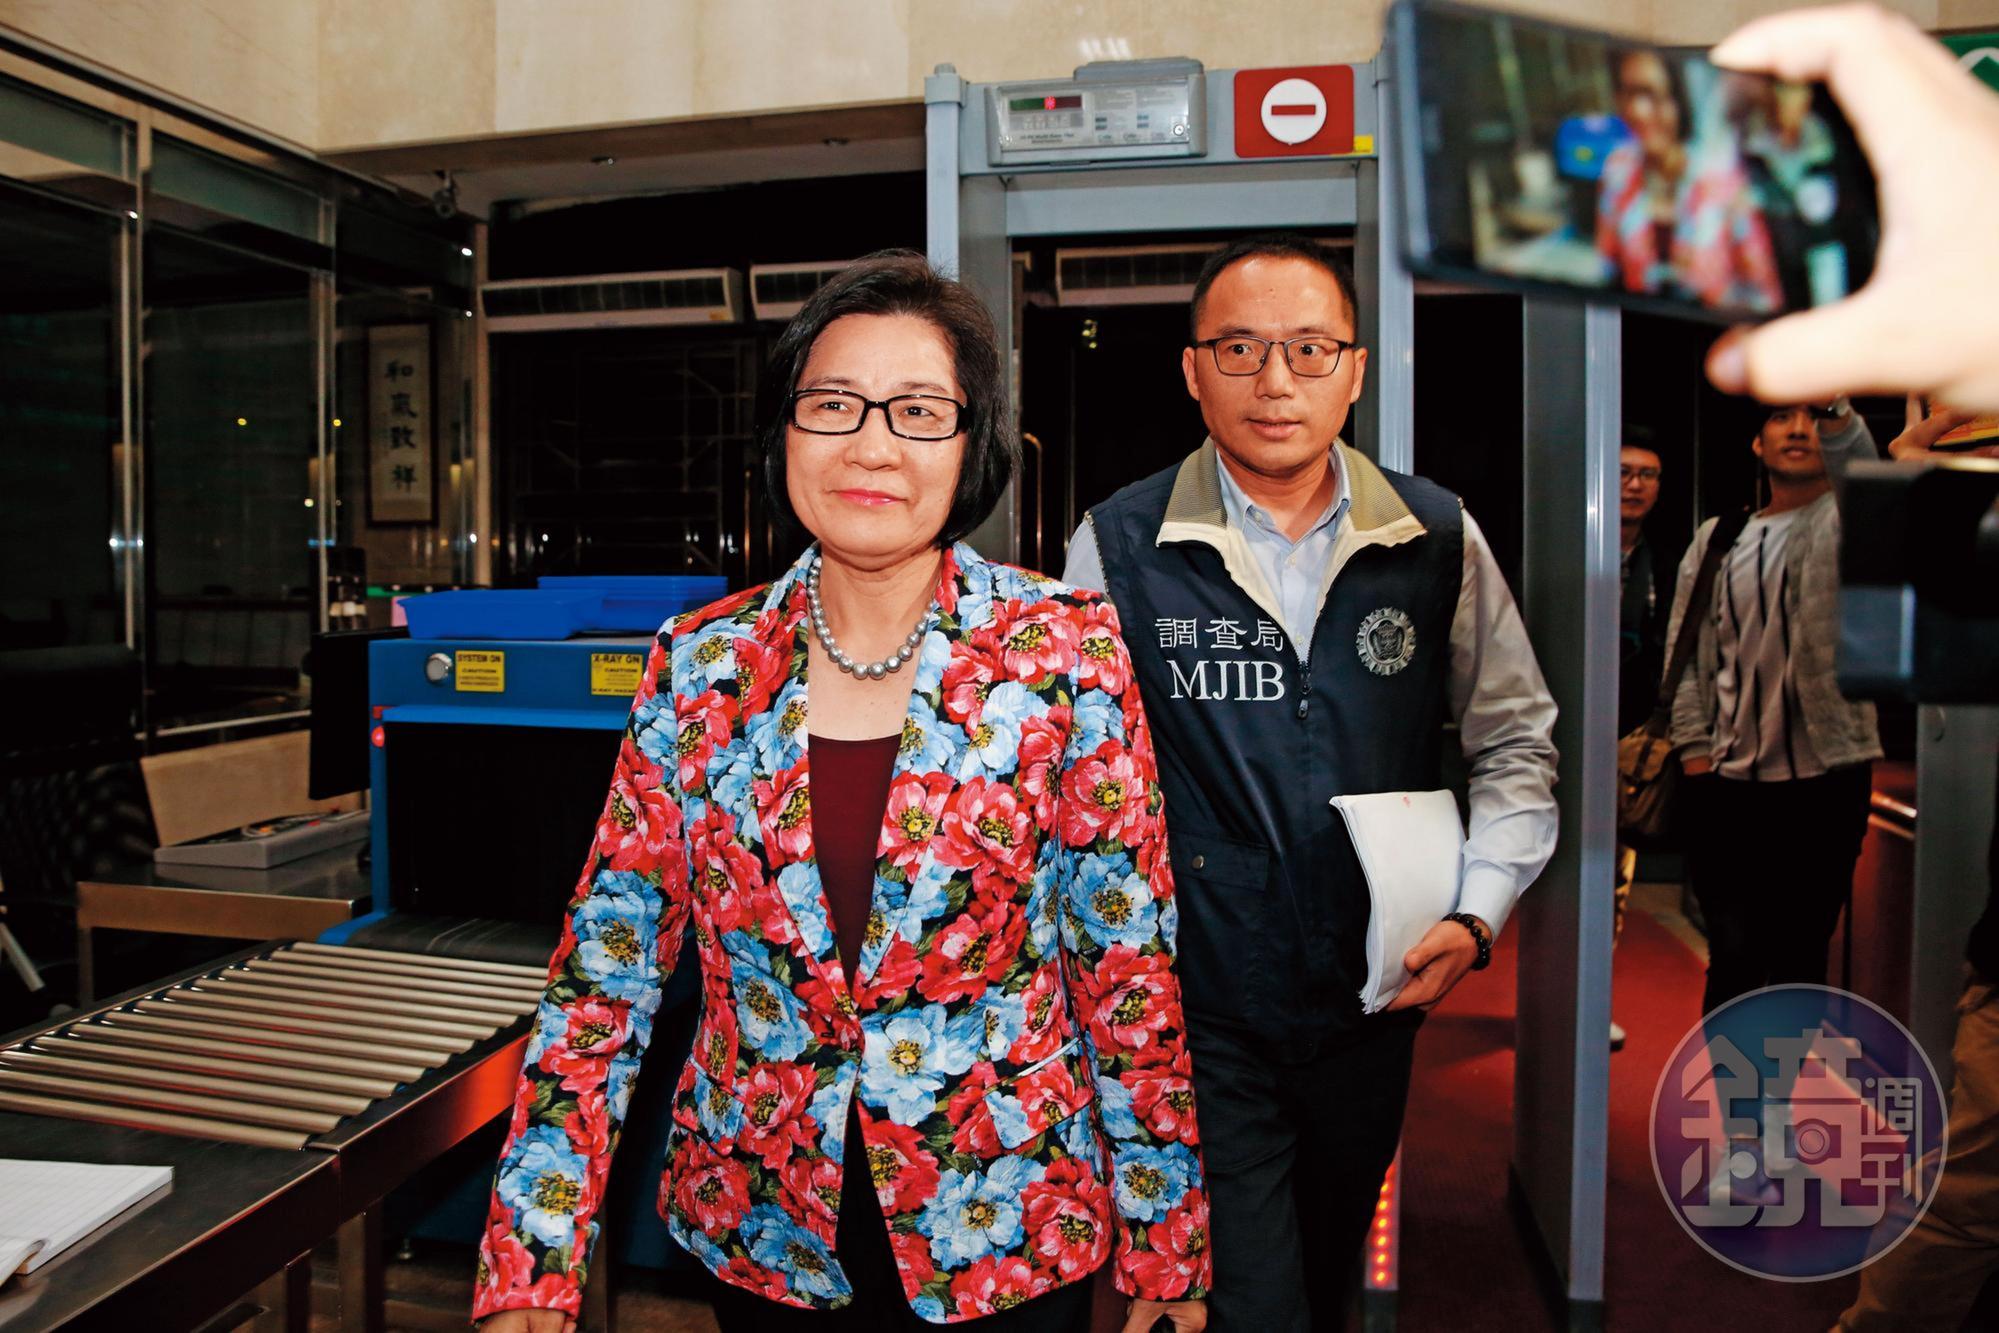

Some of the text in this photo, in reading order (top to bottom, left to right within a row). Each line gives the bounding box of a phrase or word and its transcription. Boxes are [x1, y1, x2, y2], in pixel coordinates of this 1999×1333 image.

[1154, 616, 1284, 652] 調查局
[457, 653, 488, 663] SYSTEM
[593, 654, 640, 664] X-RAY ON
[1166, 659, 1286, 701] MJIB
